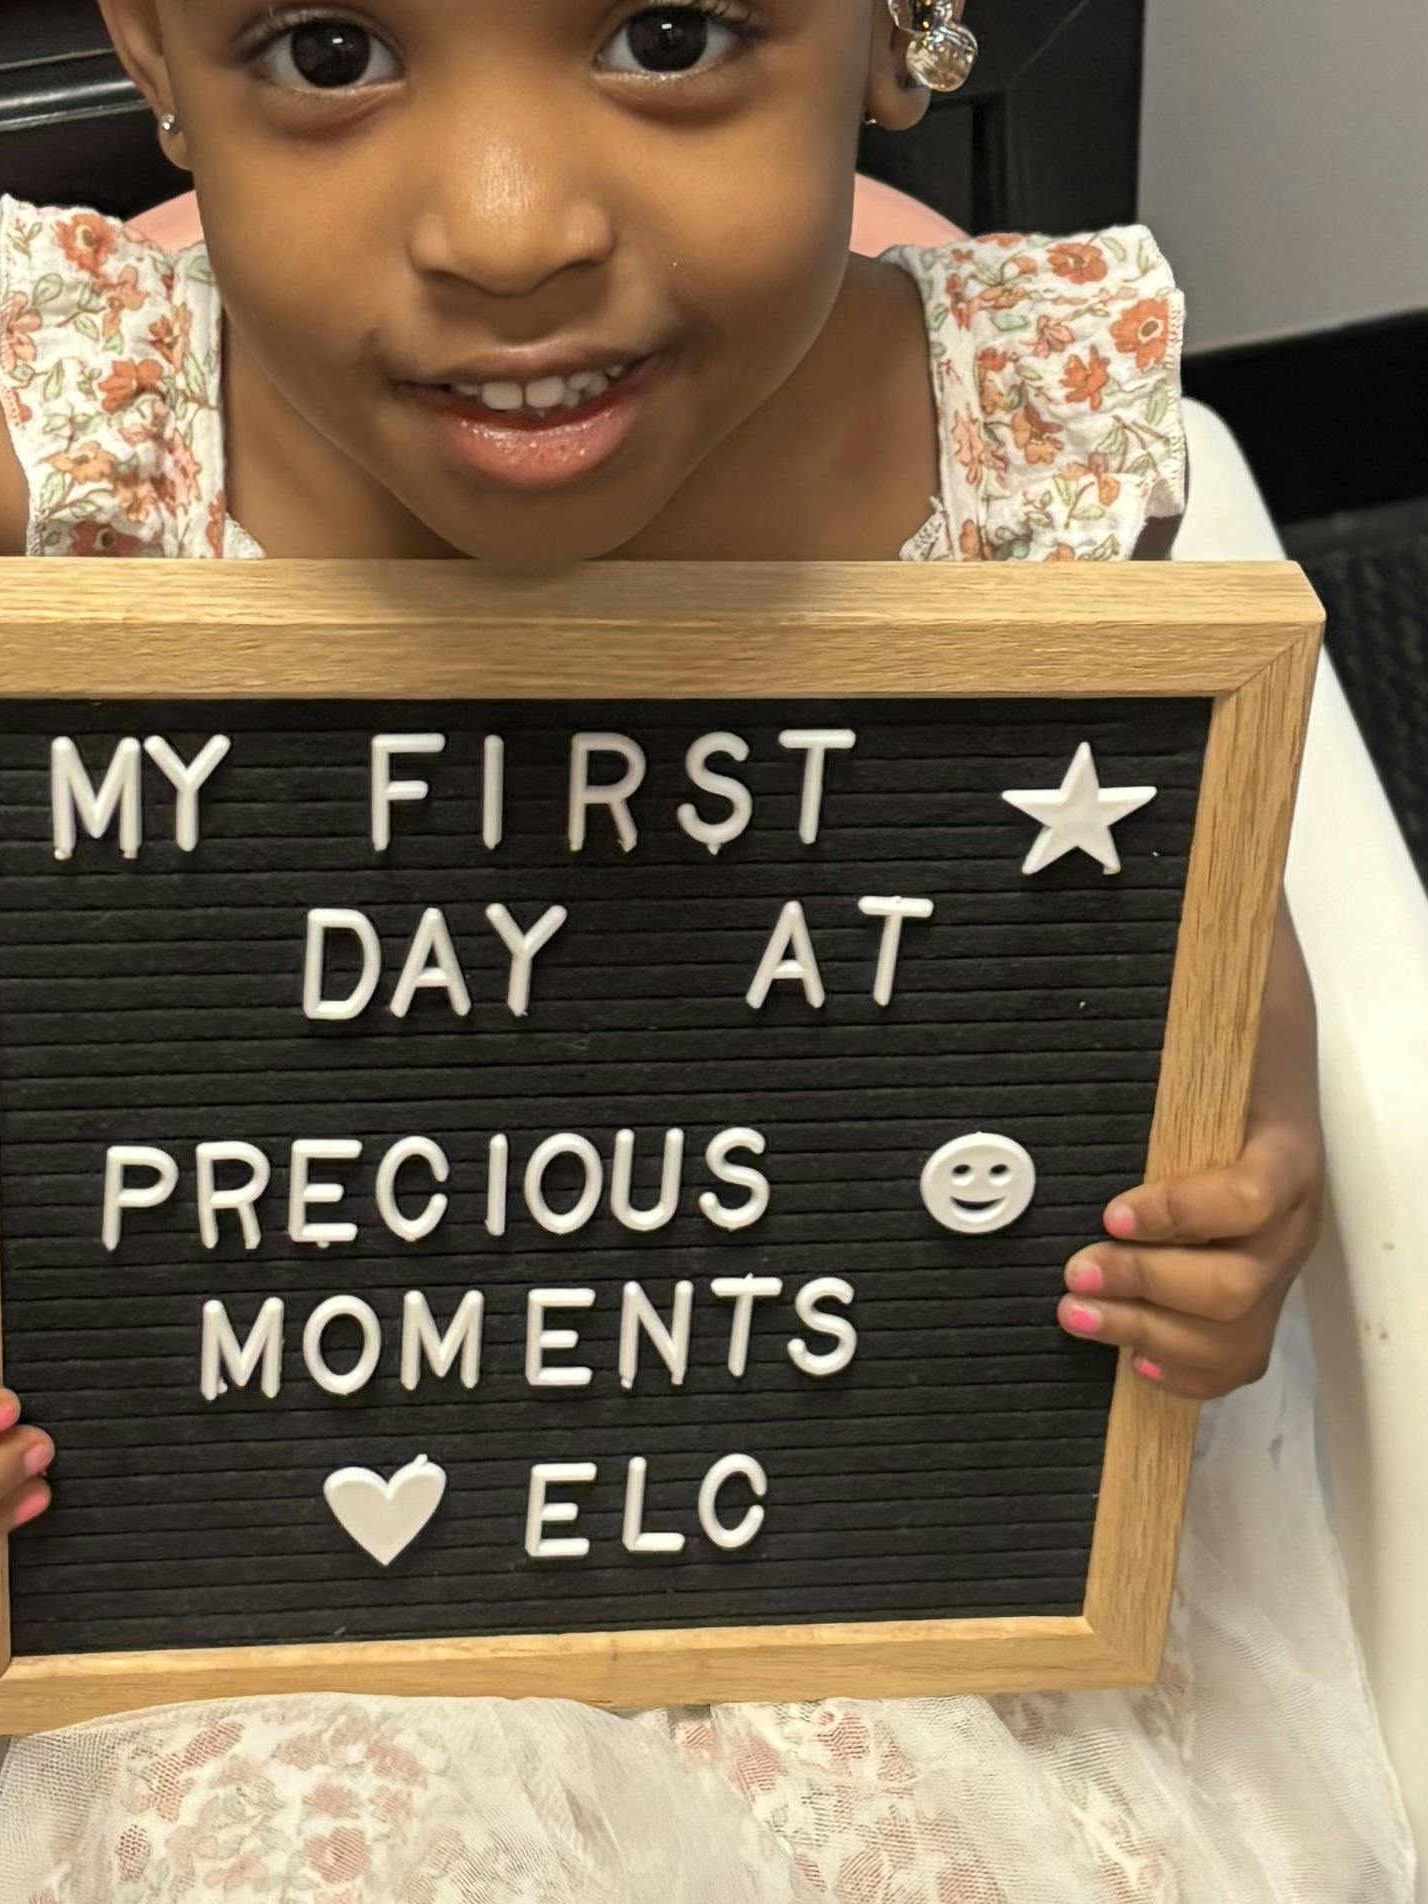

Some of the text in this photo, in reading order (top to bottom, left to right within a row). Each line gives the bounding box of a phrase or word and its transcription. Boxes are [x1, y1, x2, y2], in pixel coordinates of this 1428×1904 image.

[50, 728, 857, 861] MY FIRST
[303, 895, 935, 1021] DAY AT
[101, 1126, 771, 1251] PRECIOUS
[199, 1272, 858, 1401] MOMENTS
[523, 1453, 768, 1558] ELC
